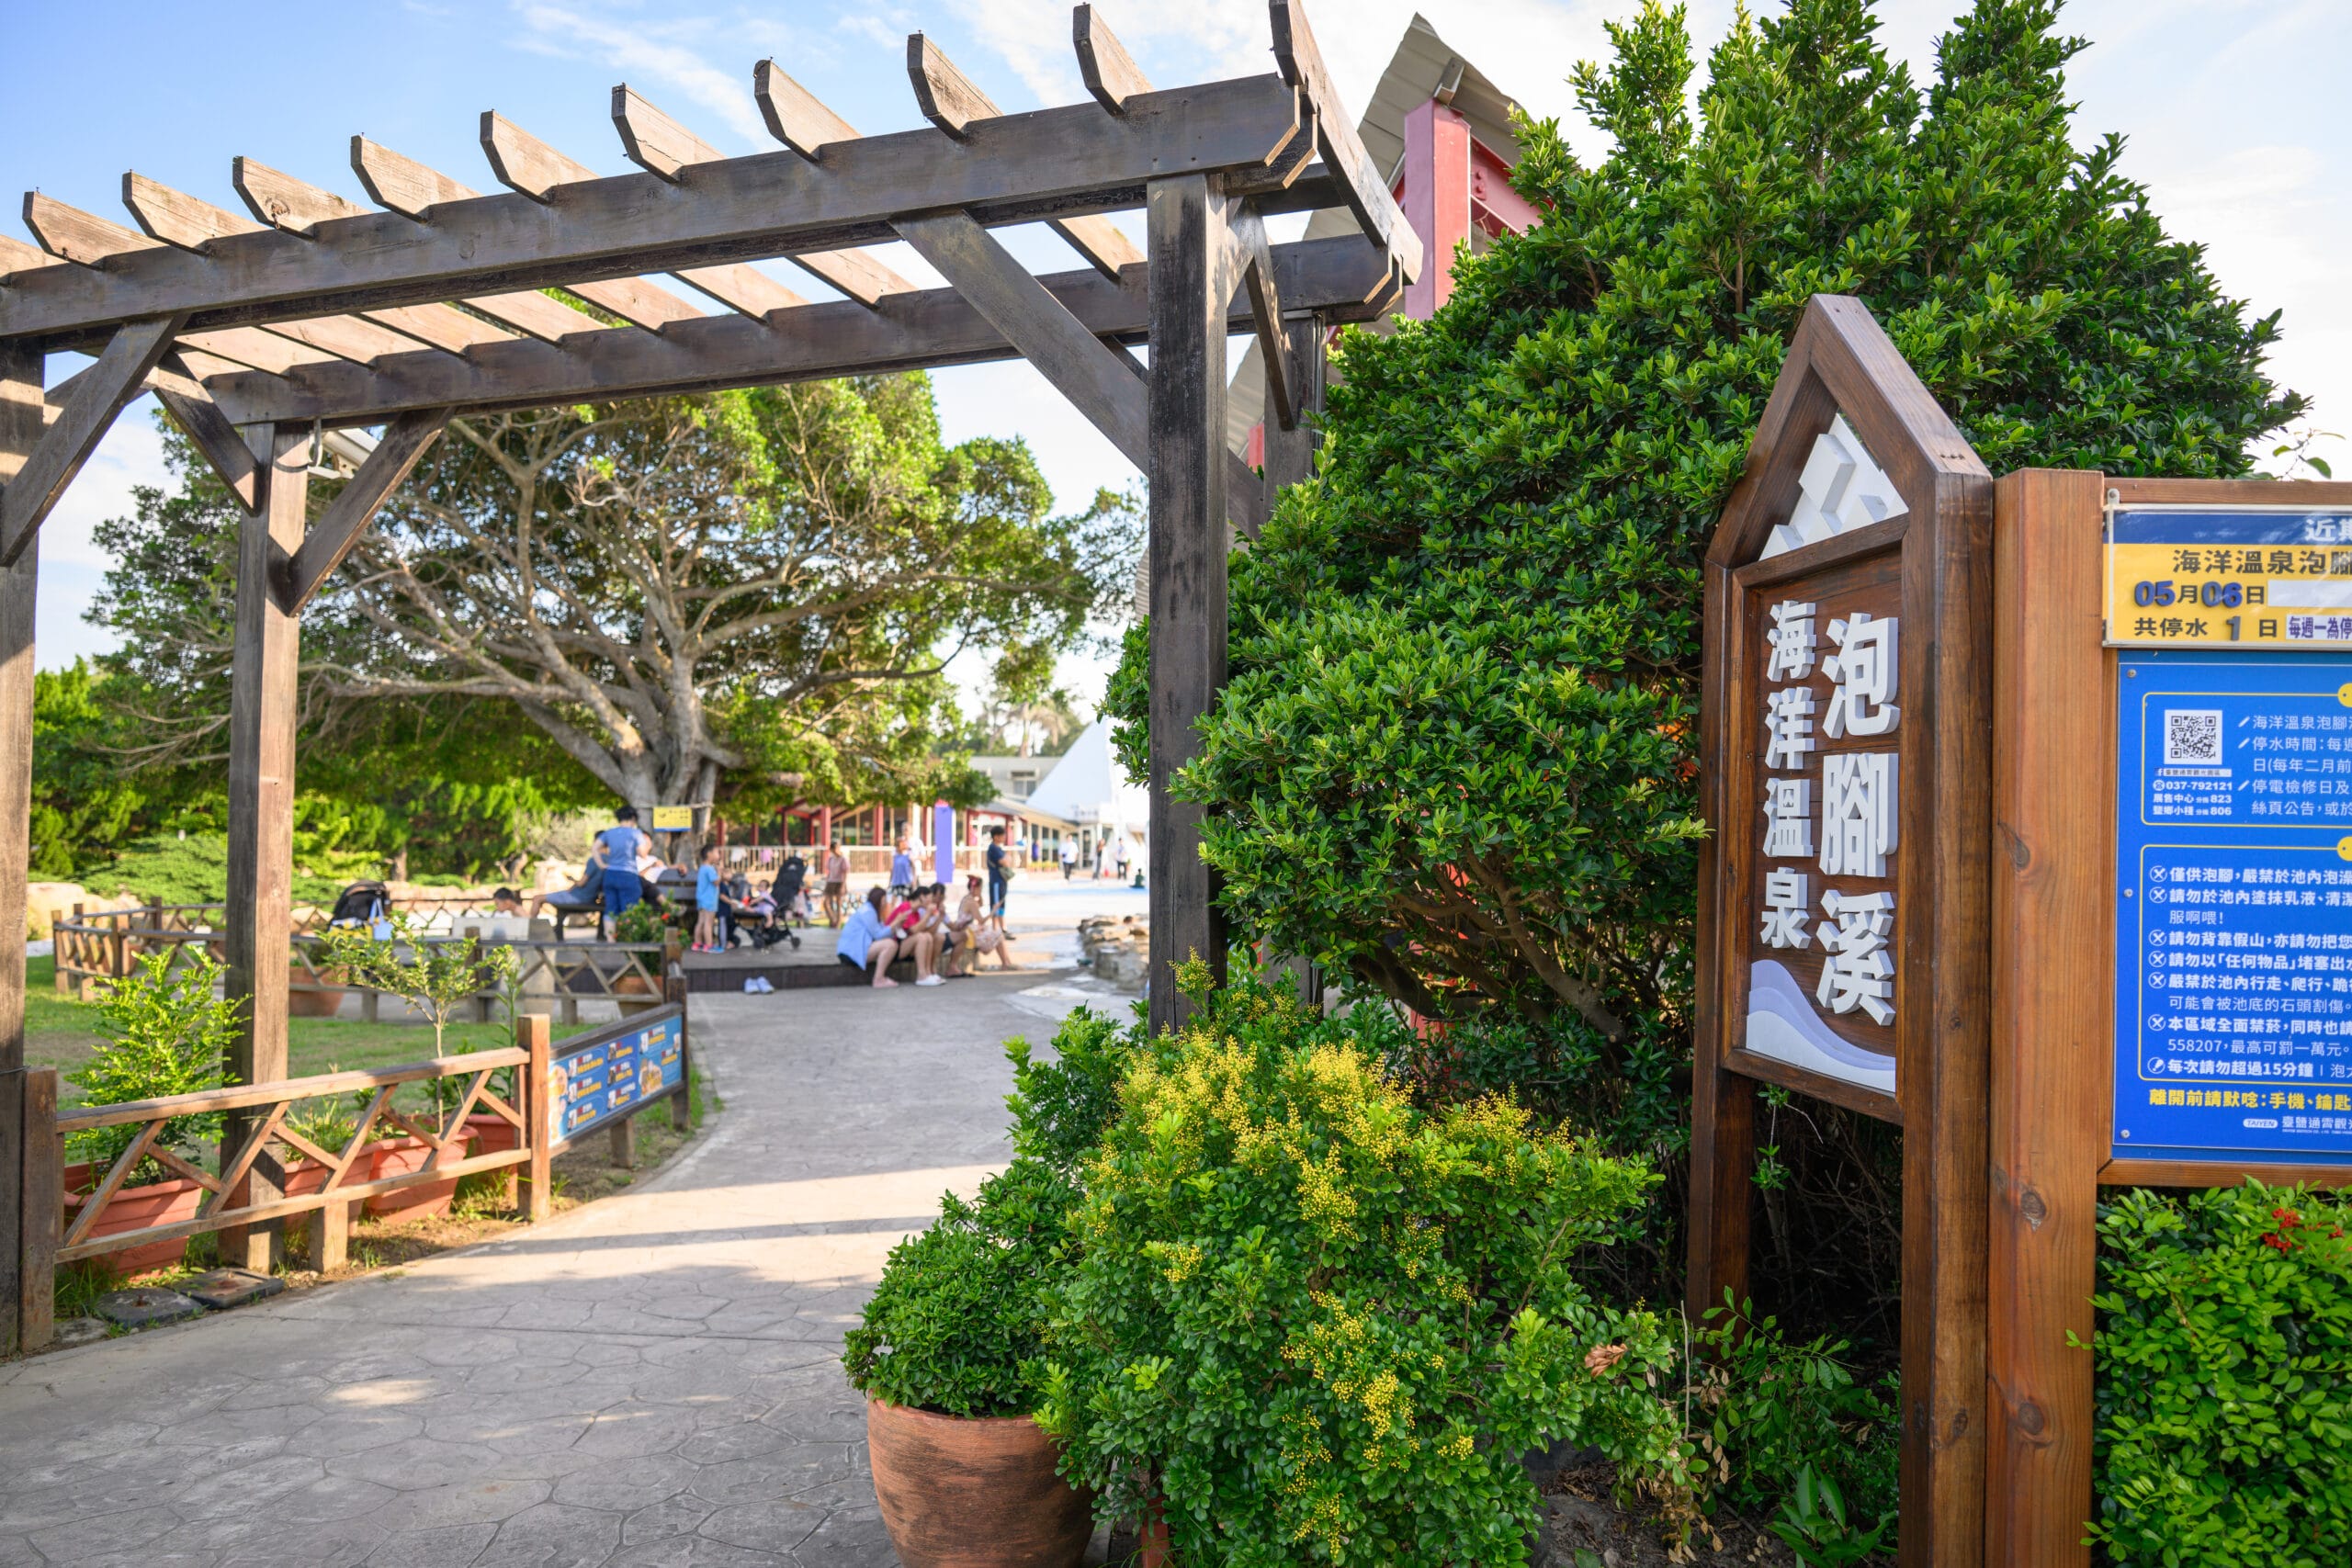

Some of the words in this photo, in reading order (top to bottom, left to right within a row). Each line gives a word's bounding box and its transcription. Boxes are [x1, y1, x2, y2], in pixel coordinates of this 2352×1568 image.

[2173, 549, 2352, 575] 海洋溫泉泡腳
[2134, 580, 2265, 608] 05月06日
[2134, 617, 2208, 637] 共停水
[2225, 615, 2242, 641] 1
[2259, 619, 2278, 638] 日
[2253, 715, 2352, 730] 海洋溫泉泡腳
[1761, 599, 1816, 949] 海洋溫泉
[2165, 780, 2233, 791] 037-792121
[2252, 778, 2350, 795] 停電檢修日及
[2210, 795, 2233, 804] 823
[1815, 613, 1901, 1027] 泡腳溪
[2210, 807, 2233, 816] 806
[2168, 974, 2352, 993] 嚴禁於池內行走、爬行、跪
